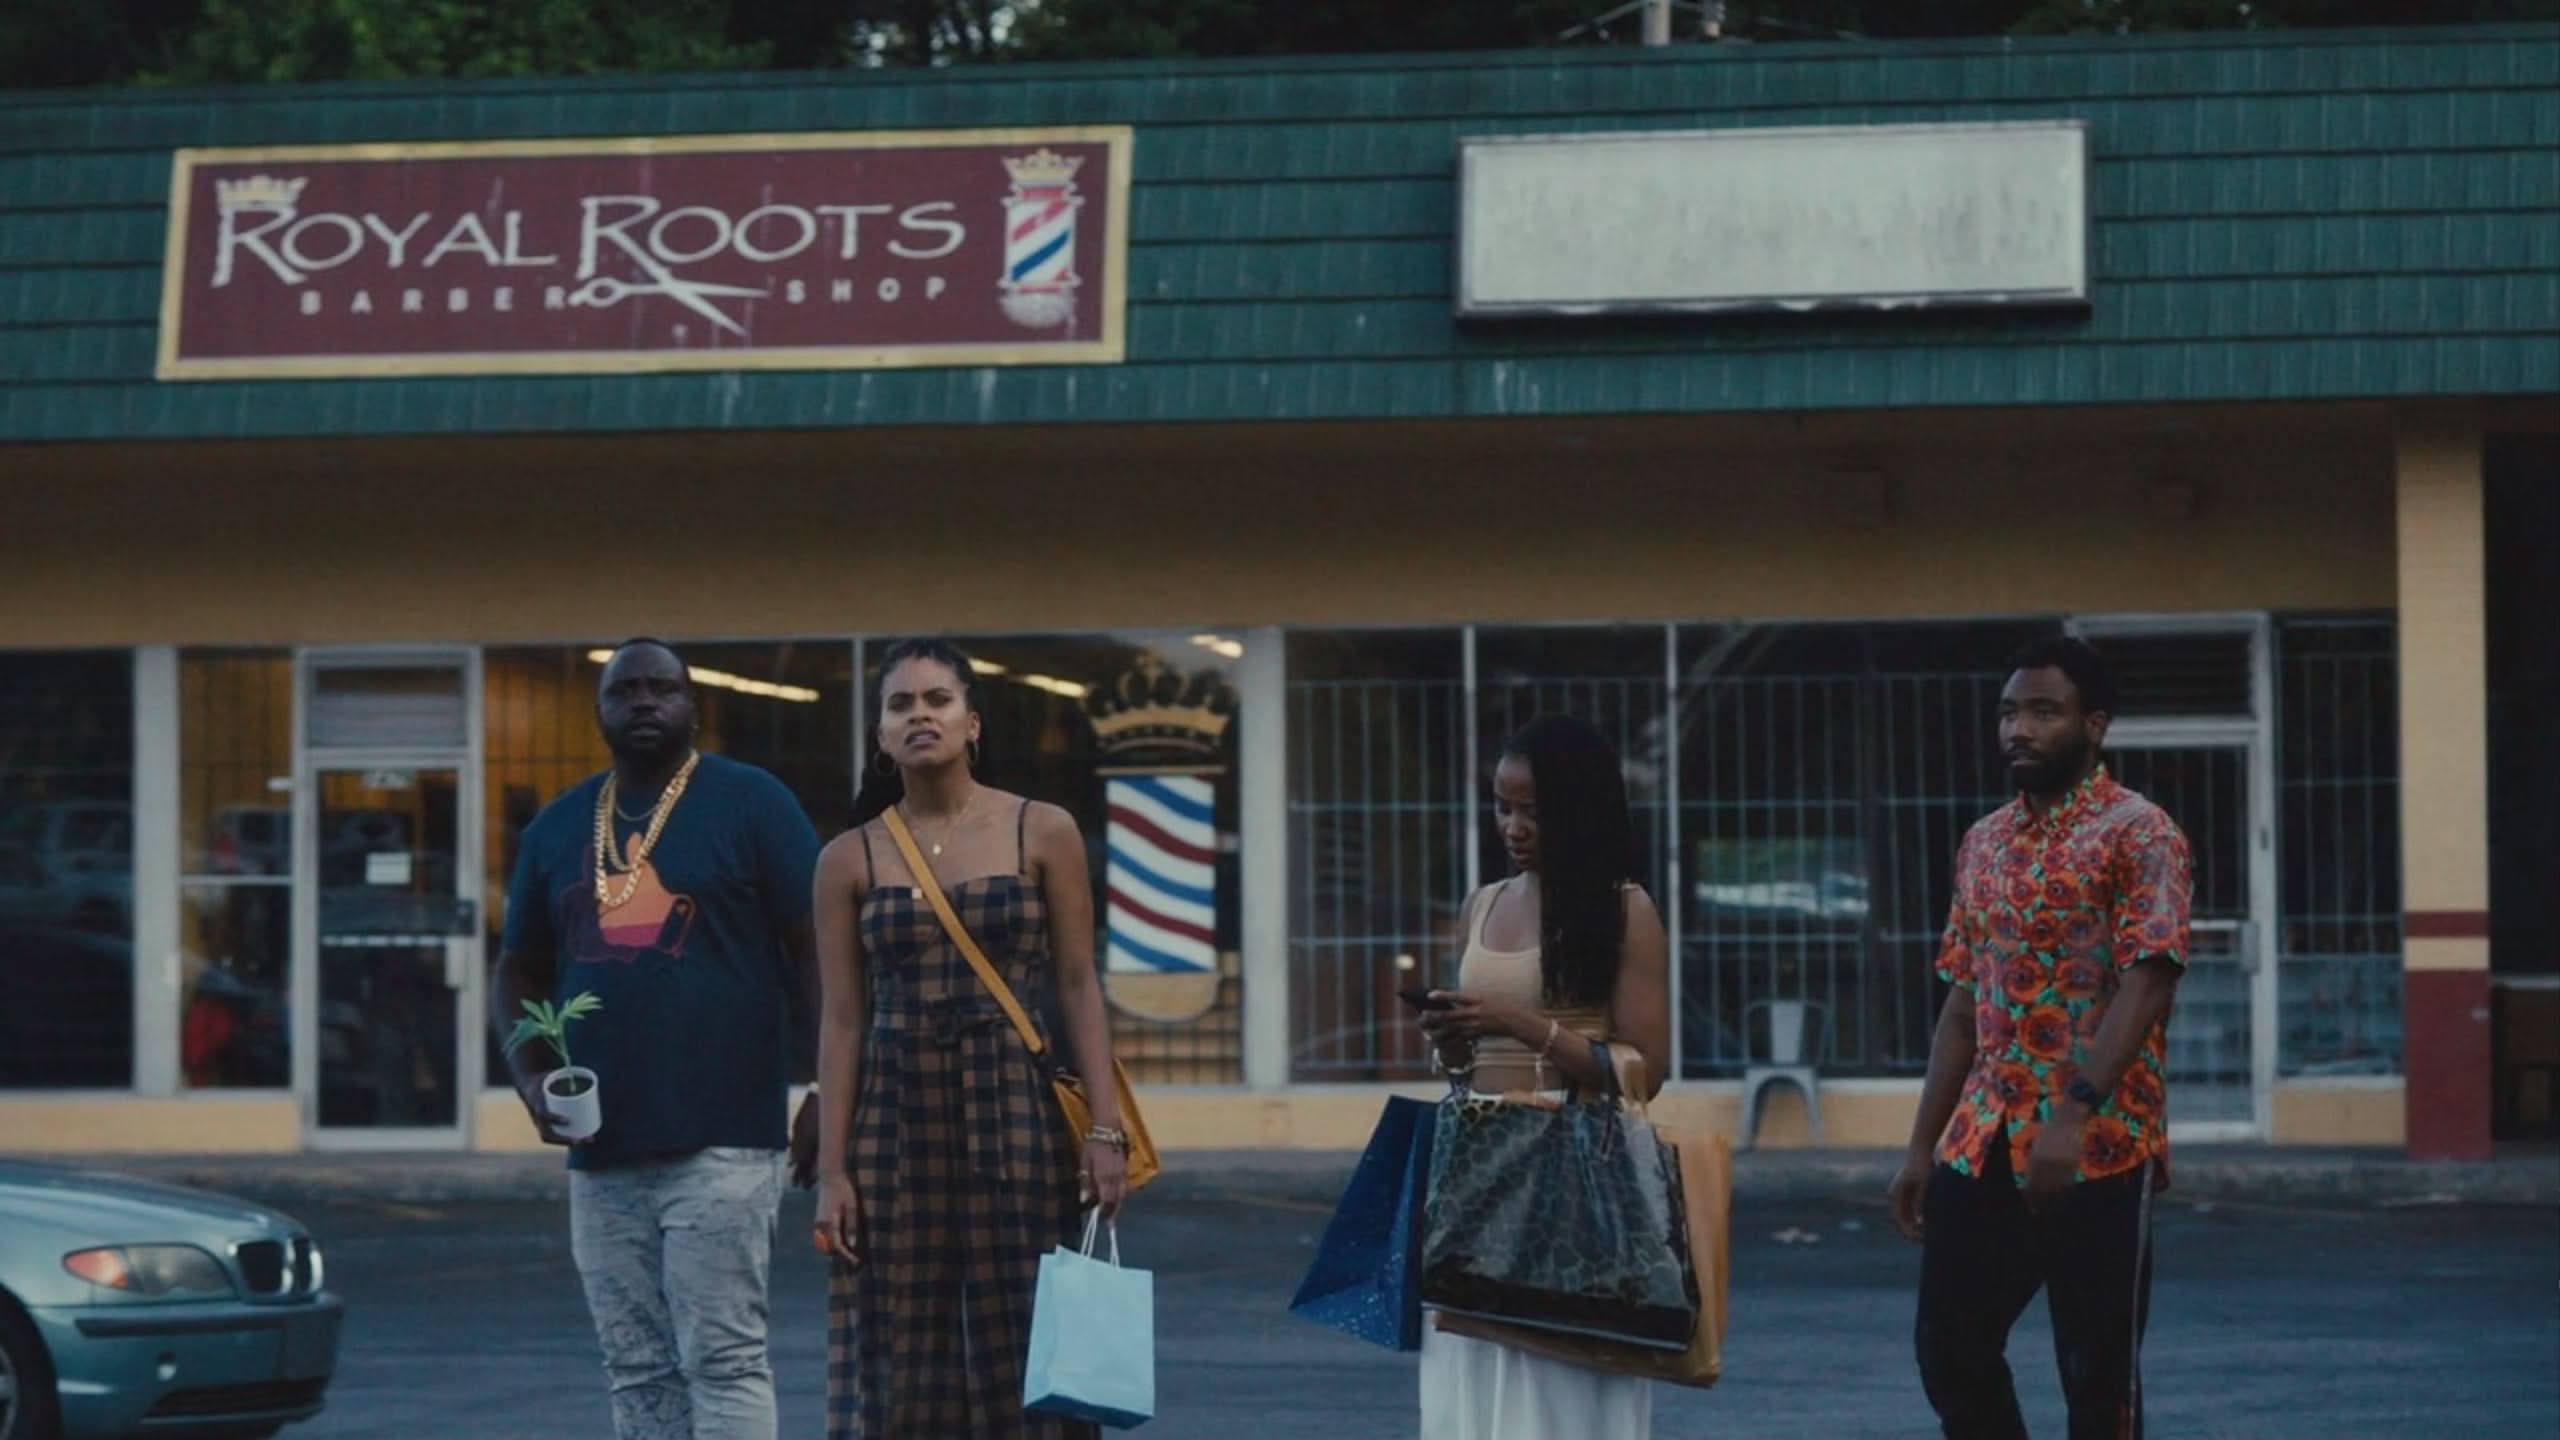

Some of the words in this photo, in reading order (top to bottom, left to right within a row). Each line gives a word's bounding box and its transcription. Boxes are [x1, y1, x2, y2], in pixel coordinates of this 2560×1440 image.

[211, 207, 559, 288] ROYAL
[576, 196, 967, 281] ROOTS
[300, 286, 567, 315] BARBER
[785, 277, 947, 304] SHOP
